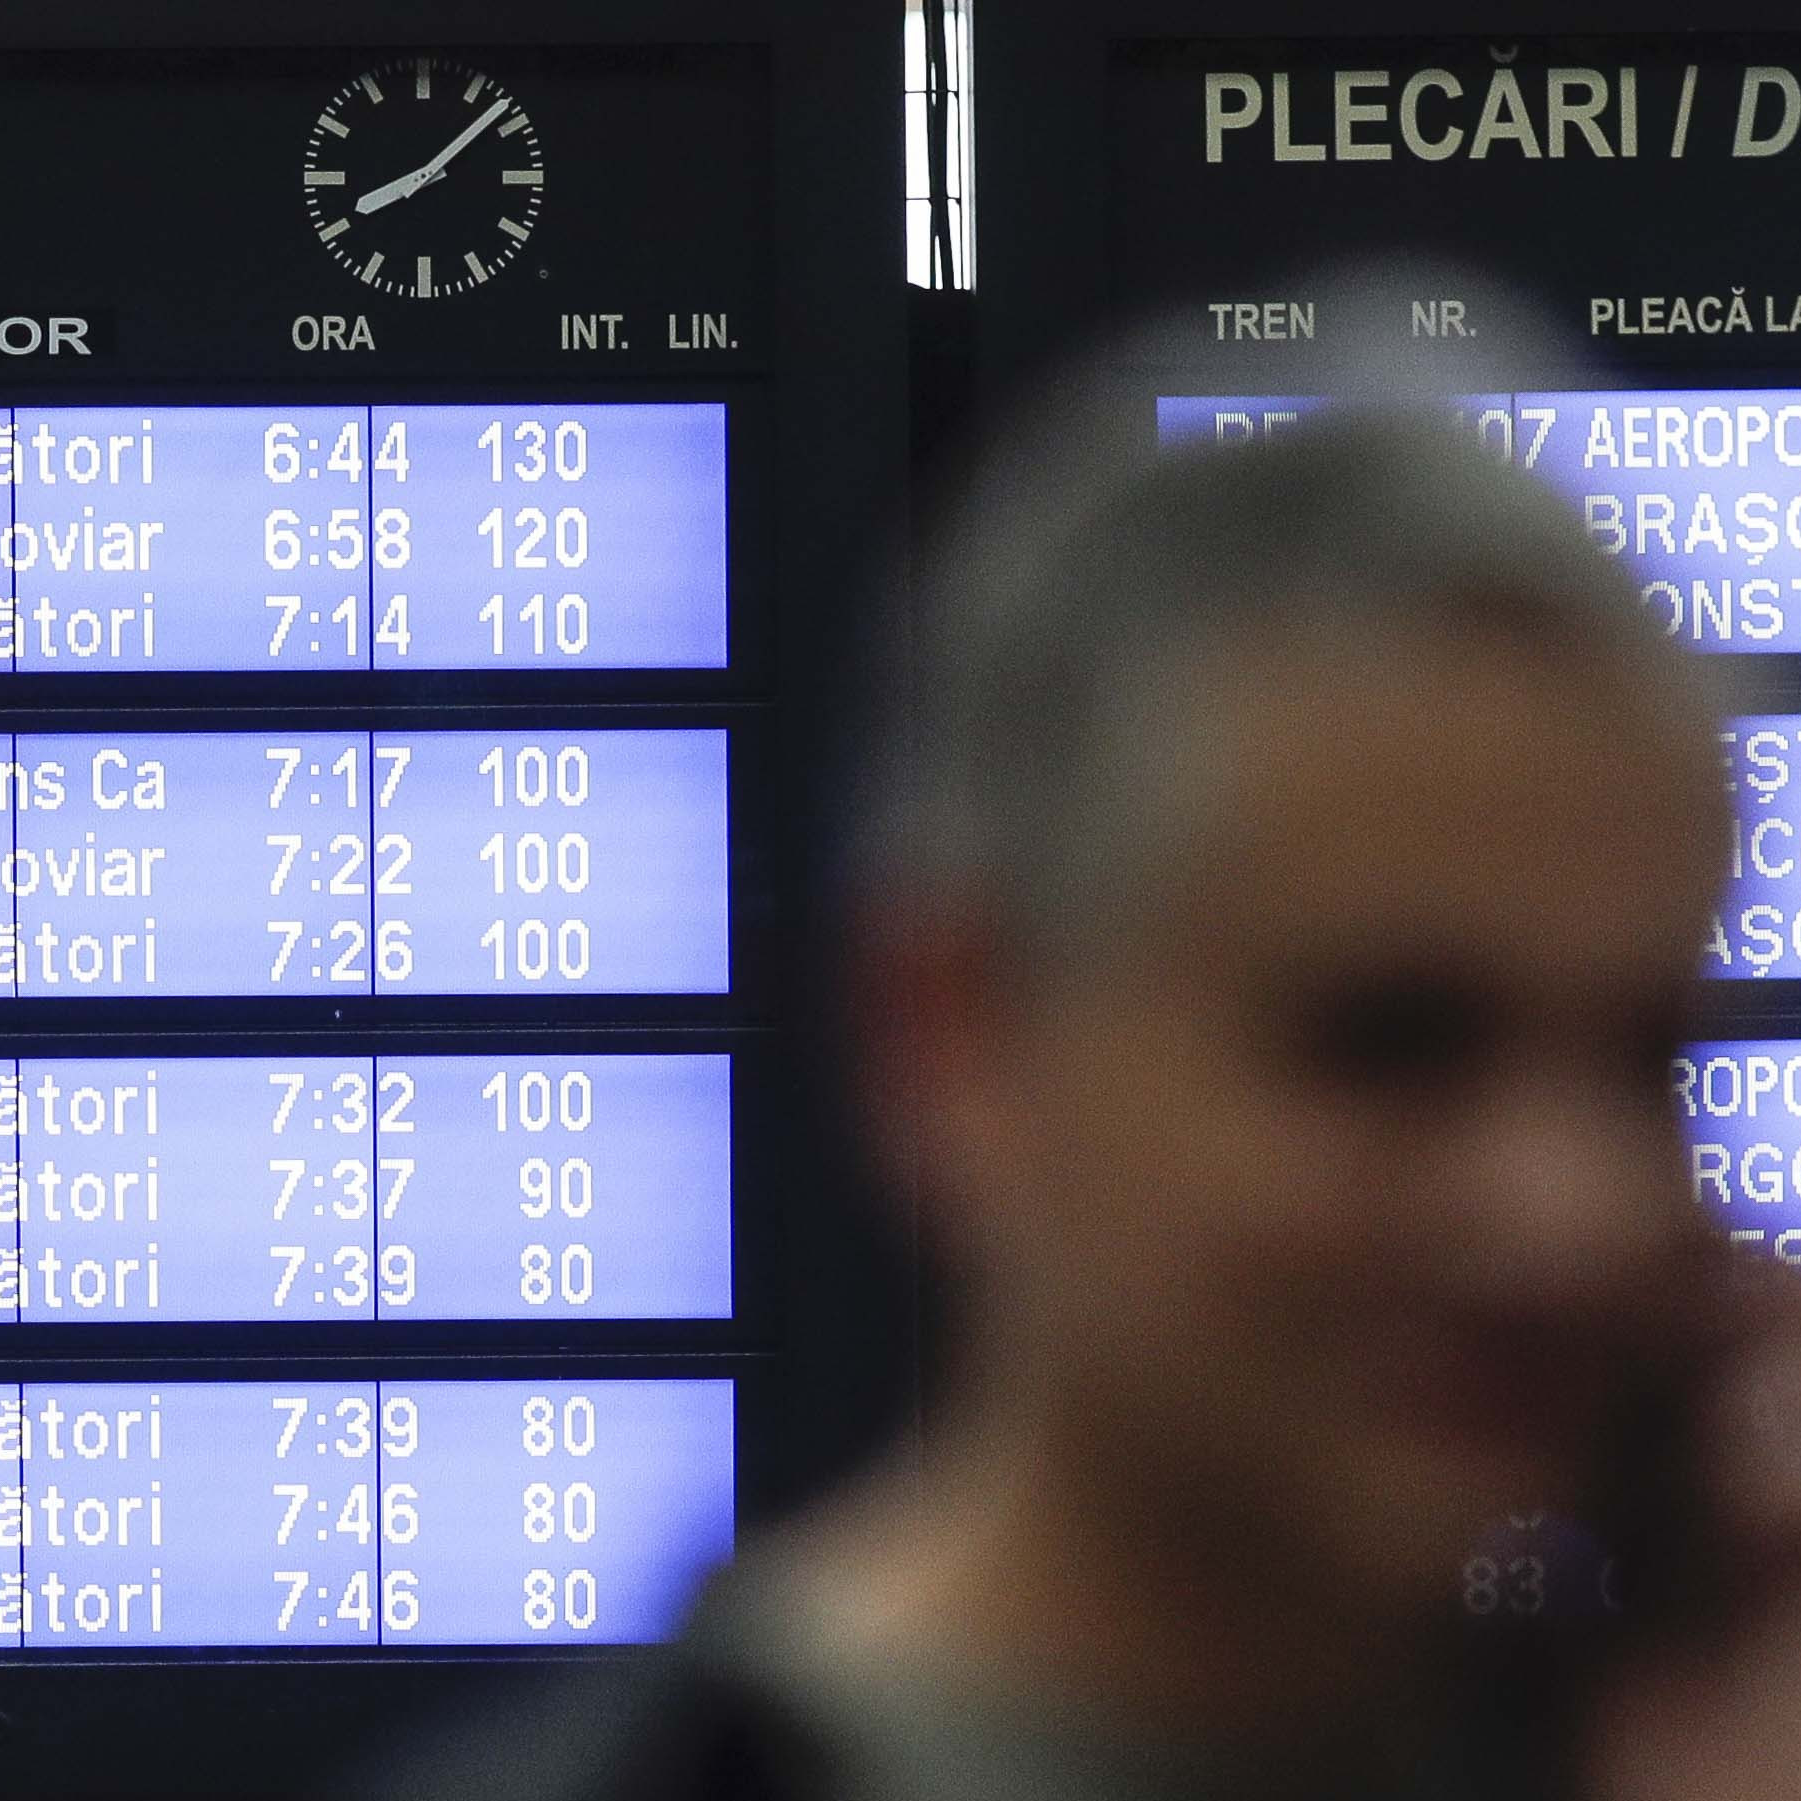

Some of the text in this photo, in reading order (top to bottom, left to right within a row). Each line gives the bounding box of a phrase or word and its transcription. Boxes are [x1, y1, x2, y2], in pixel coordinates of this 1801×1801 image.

[1206, 45, 1637, 163] PLECĂRI
[1671, 67, 1696, 158] /
[292, 315, 375, 352] ORA
[561, 314, 629, 350] INT.
[668, 314, 738, 350] LIN.
[1209, 303, 1314, 340] TREN
[1410, 301, 1478, 339] NR.
[1591, 287, 1753, 335] PLEACĂ
[265, 423, 408, 482] 6:44
[479, 422, 585, 481] 130
[266, 509, 409, 569] 6:58
[479, 508, 587, 567] 120
[266, 595, 410, 655] 7:14
[480, 595, 587, 654] 110
[93, 750, 164, 809] Ca
[267, 748, 410, 808] 7:17
[480, 747, 587, 806] 100
[267, 835, 411, 894] 7:22
[480, 833, 588, 893] 100
[270, 1073, 413, 1133] 7:32
[483, 1072, 590, 1131] 100
[270, 1159, 414, 1219] 7:37
[520, 1159, 591, 1217] 90
[273, 1398, 417, 1457] 7:39
[524, 1397, 594, 1456] 80
[275, 1571, 418, 1630] 7:46
[525, 1570, 595, 1628] 80
